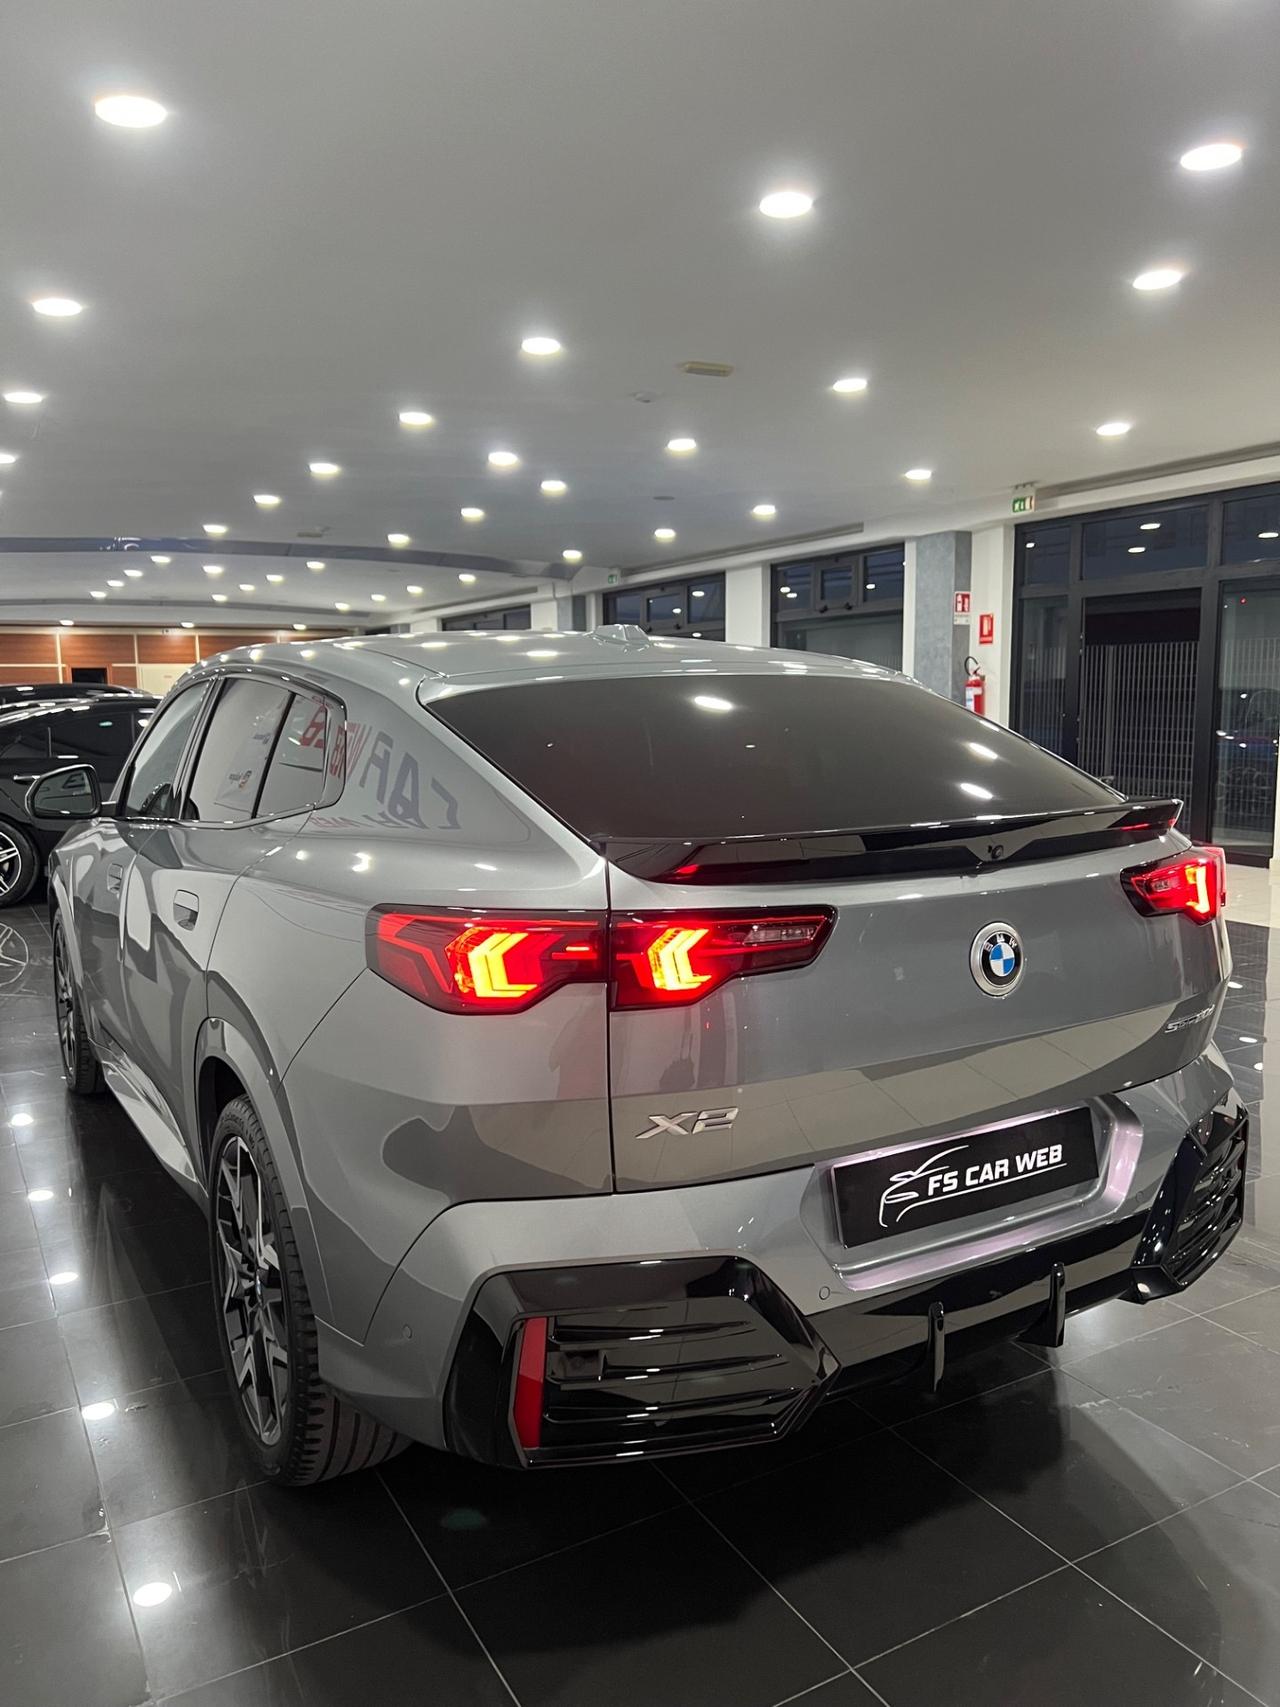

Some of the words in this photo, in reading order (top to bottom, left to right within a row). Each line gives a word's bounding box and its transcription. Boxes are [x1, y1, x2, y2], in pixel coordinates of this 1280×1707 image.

[635, 1106, 738, 1139] X2
[927, 1170, 959, 1197] FS
[965, 1158, 1009, 1187] CAR
[1015, 1144, 1063, 1173] WEB
